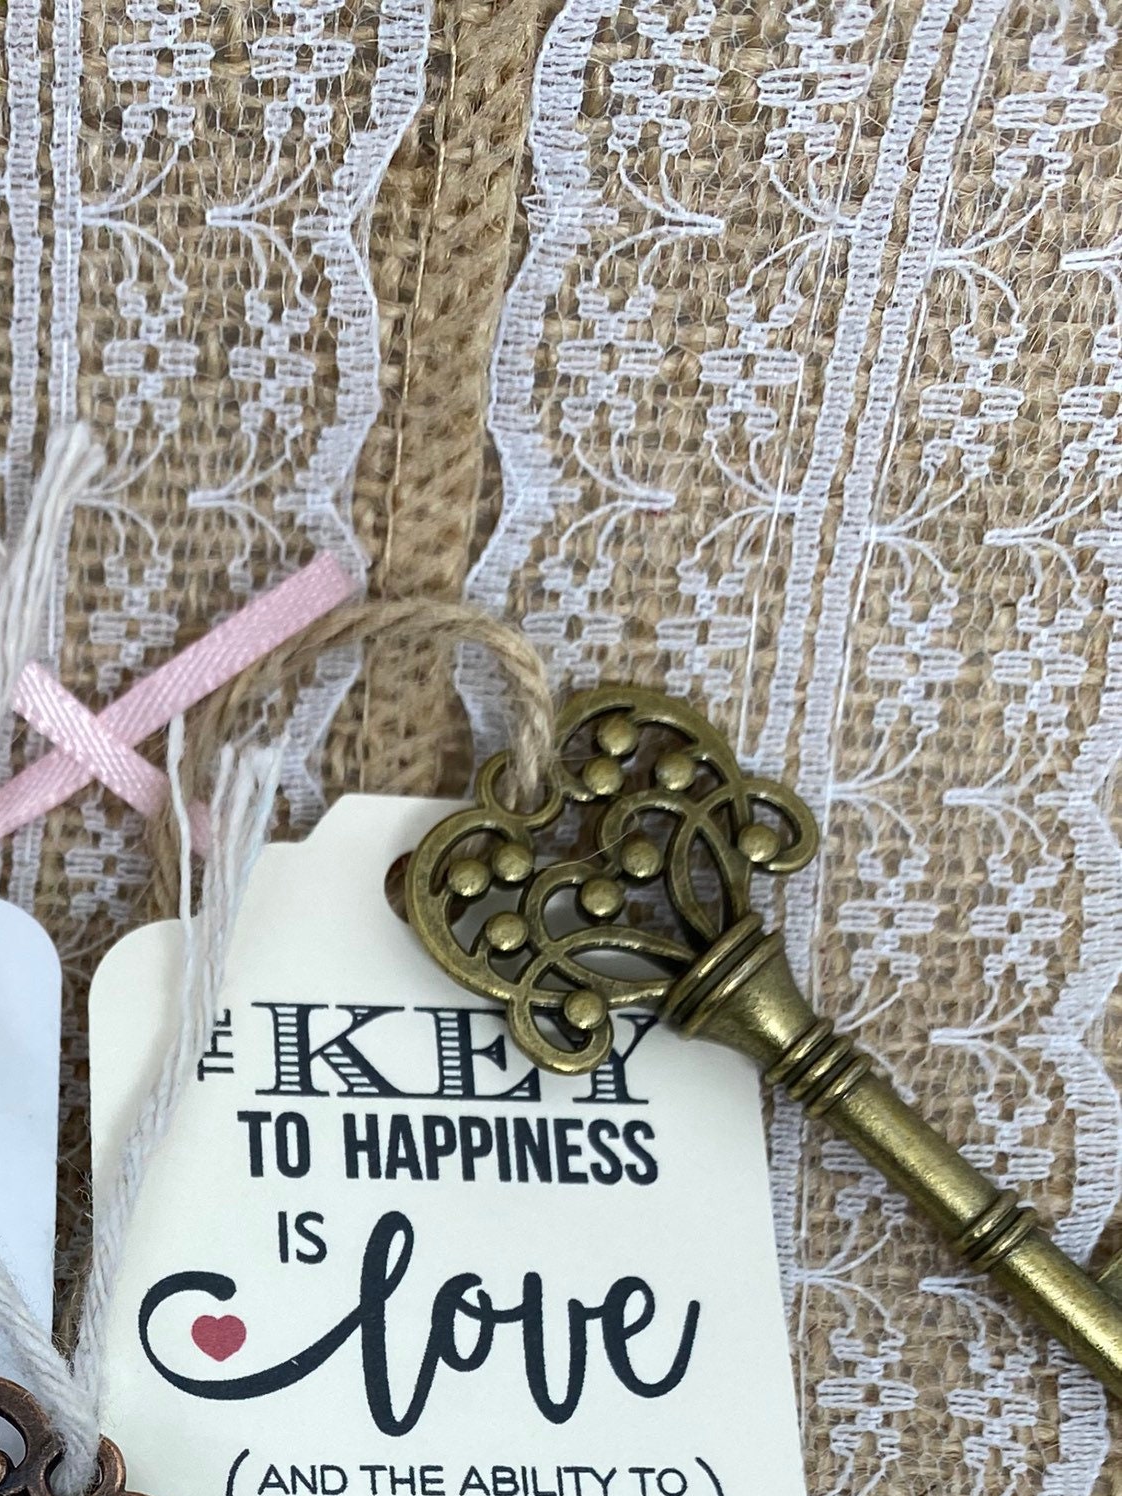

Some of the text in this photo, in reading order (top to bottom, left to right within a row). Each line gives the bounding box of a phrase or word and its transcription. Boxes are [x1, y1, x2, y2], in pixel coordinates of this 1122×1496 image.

[236, 1109, 660, 1186] TO HAPPINESS
[137, 1209, 702, 1438] IS love
[358, 1464, 447, 1496] THE
